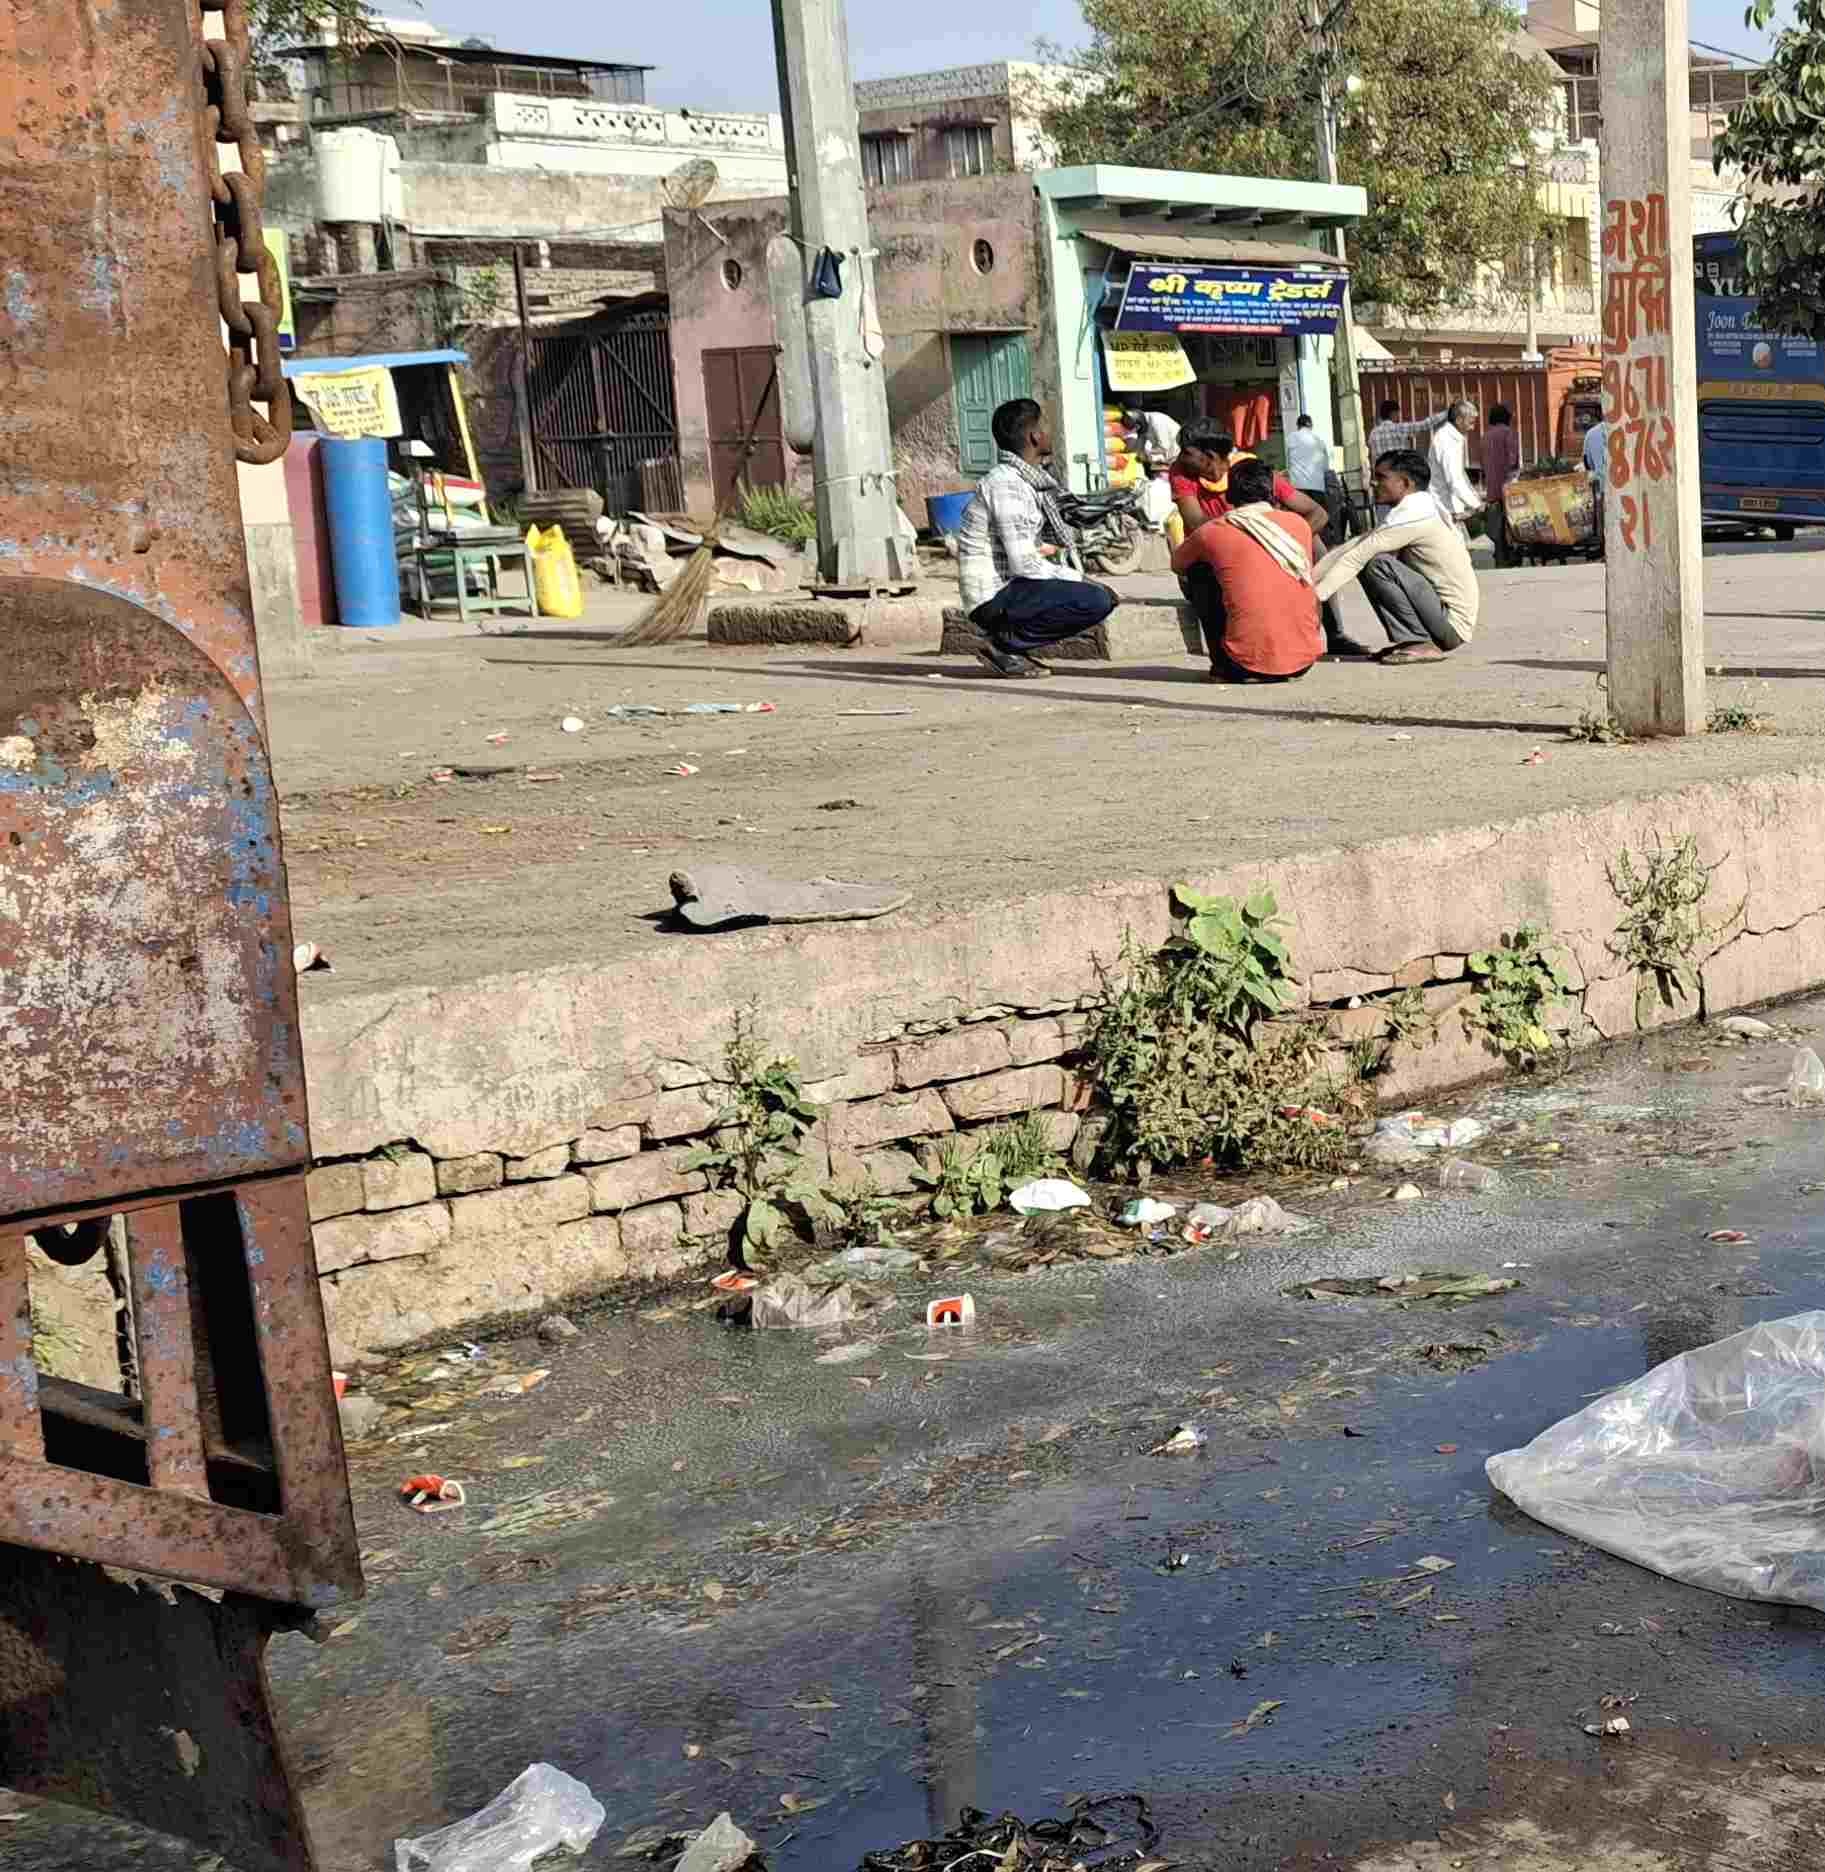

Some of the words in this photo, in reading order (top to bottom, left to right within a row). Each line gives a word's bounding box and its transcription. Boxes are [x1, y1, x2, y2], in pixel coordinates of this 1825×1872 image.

[1148, 274, 1188, 293] श्री
[1194, 280, 1264, 300] कृष्ण
[1268, 278, 1335, 301] ट्रेडर्स
[1602, 356, 1667, 423] 9671
